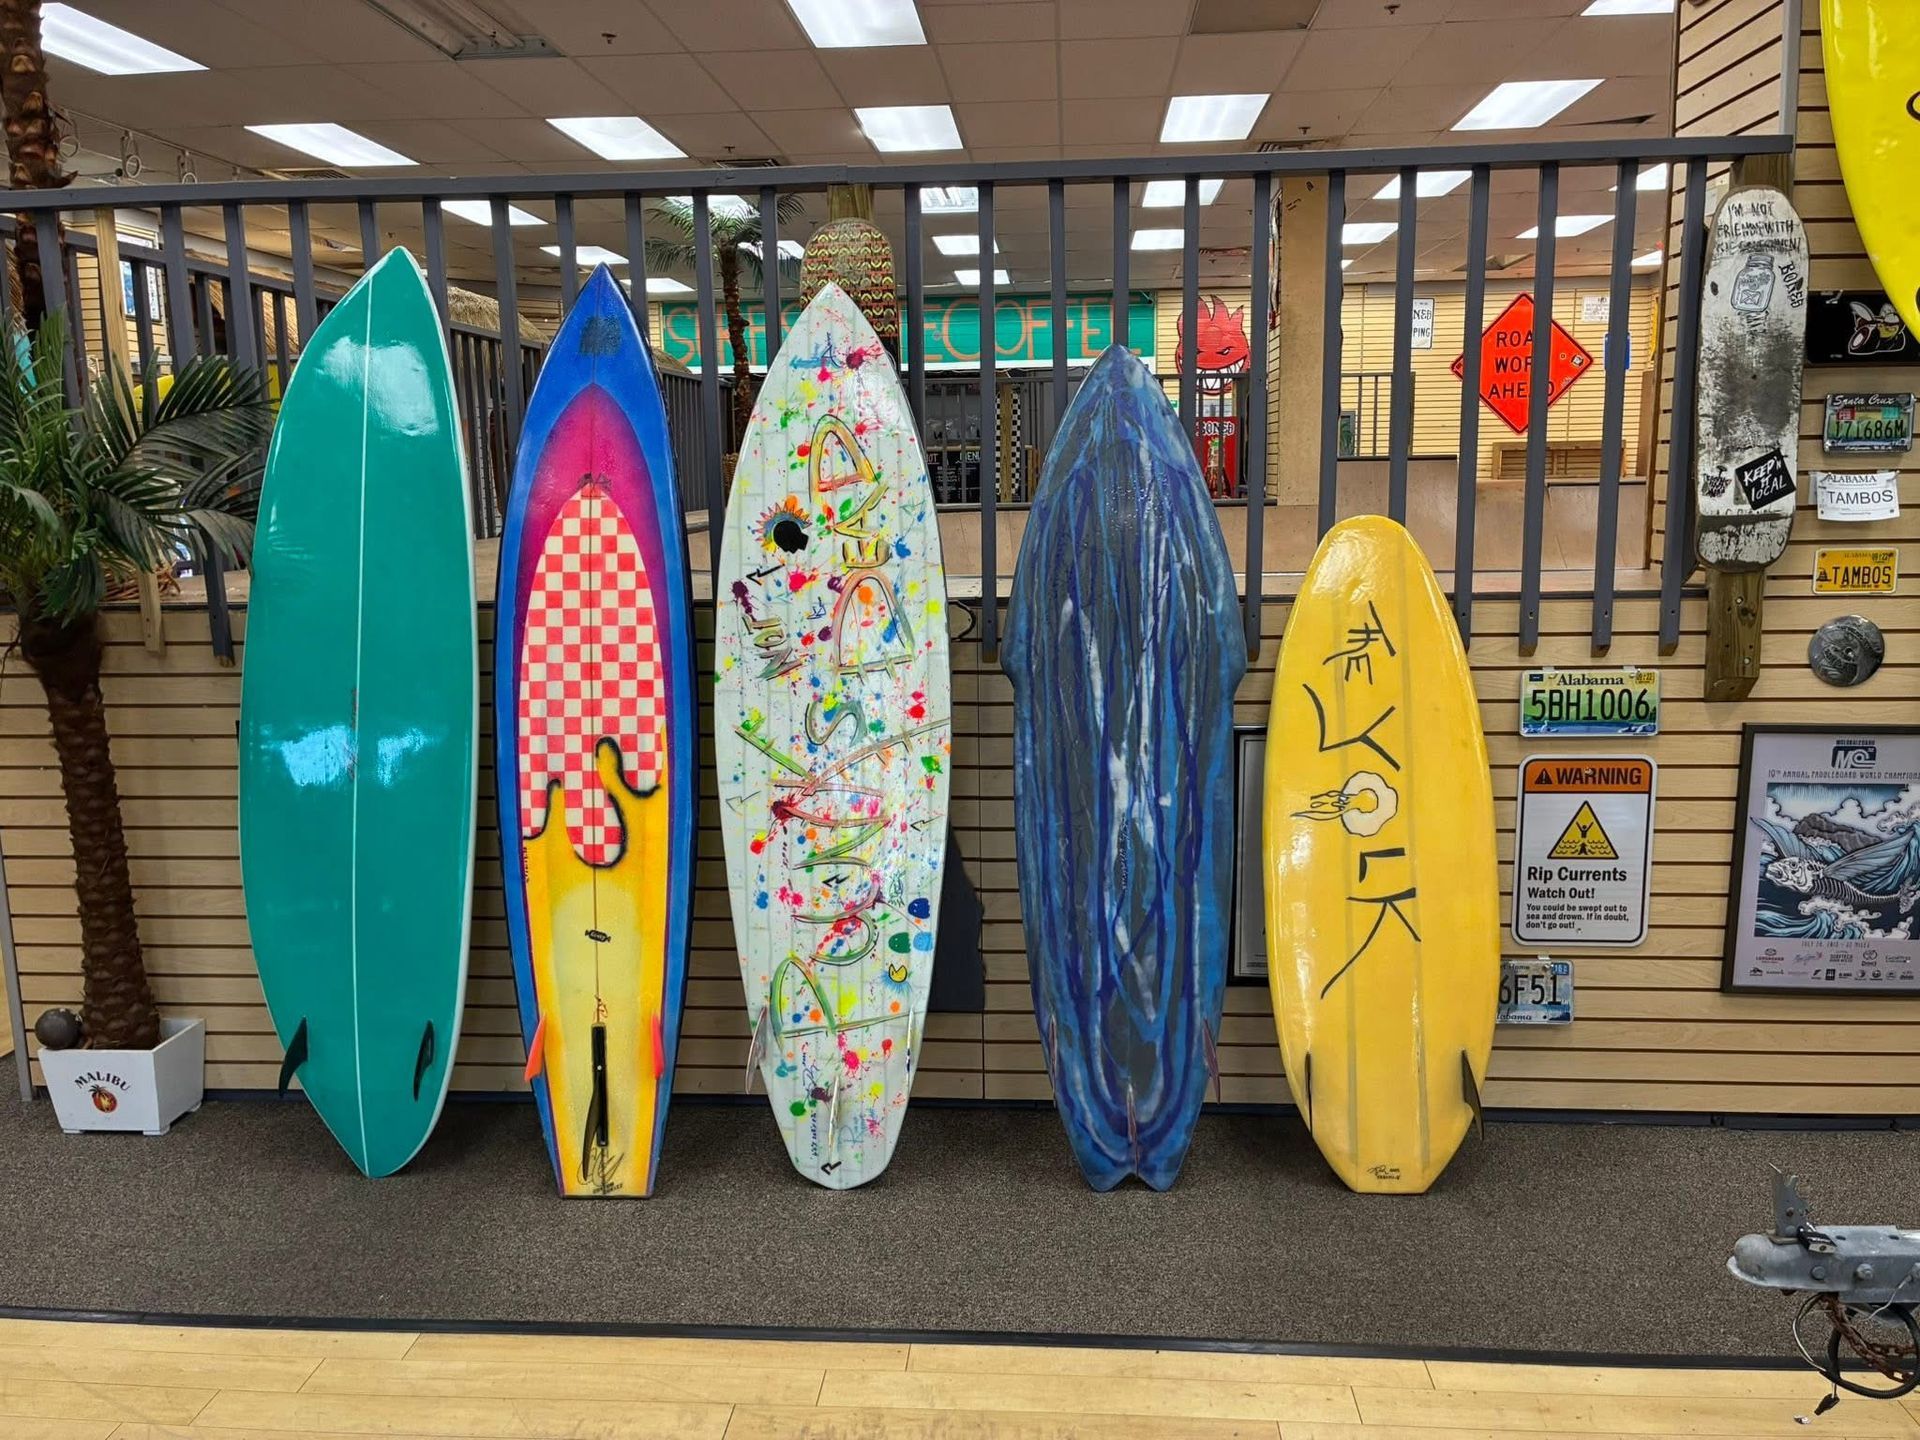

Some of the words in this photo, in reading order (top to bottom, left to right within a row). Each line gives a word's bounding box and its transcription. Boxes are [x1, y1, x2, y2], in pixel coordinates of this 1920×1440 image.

[1751, 201, 1775, 217] NOT
[1765, 220, 1794, 234] WITH
[1496, 331, 1534, 348] ROA
[1488, 381, 1555, 399] AHED
[1833, 394, 1865, 405] Santa
[1868, 393, 1896, 405] Cruz
[1827, 474, 1877, 483] ALABAMA
[1828, 489, 1894, 505] TAMBOS
[1832, 566, 1892, 585] TAMBOS
[1557, 674, 1624, 685] Alabama
[1531, 689, 1650, 720] 5BH1006
[1556, 767, 1642, 785] WARNING
[1527, 866, 1553, 883] Rip
[1557, 867, 1627, 881] Currents
[1527, 887, 1565, 899] Watch
[1569, 887, 1595, 899] Out!
[1526, 903, 1541, 911] You
[1543, 903, 1564, 912] could
[1566, 904, 1577, 912] be
[1578, 905, 1602, 914] swept
[1542, 912, 1556, 920] and
[1558, 912, 1584, 921] drown.
[1586, 912, 1593, 921] If
[1594, 913, 1602, 921] in
[1603, 913, 1629, 922] doubt,
[1526, 921, 1547, 929] don't
[1547, 922, 1557, 930] go
[1559, 921, 1575, 929] out!
[75, 1071, 131, 1091] MALIBU
